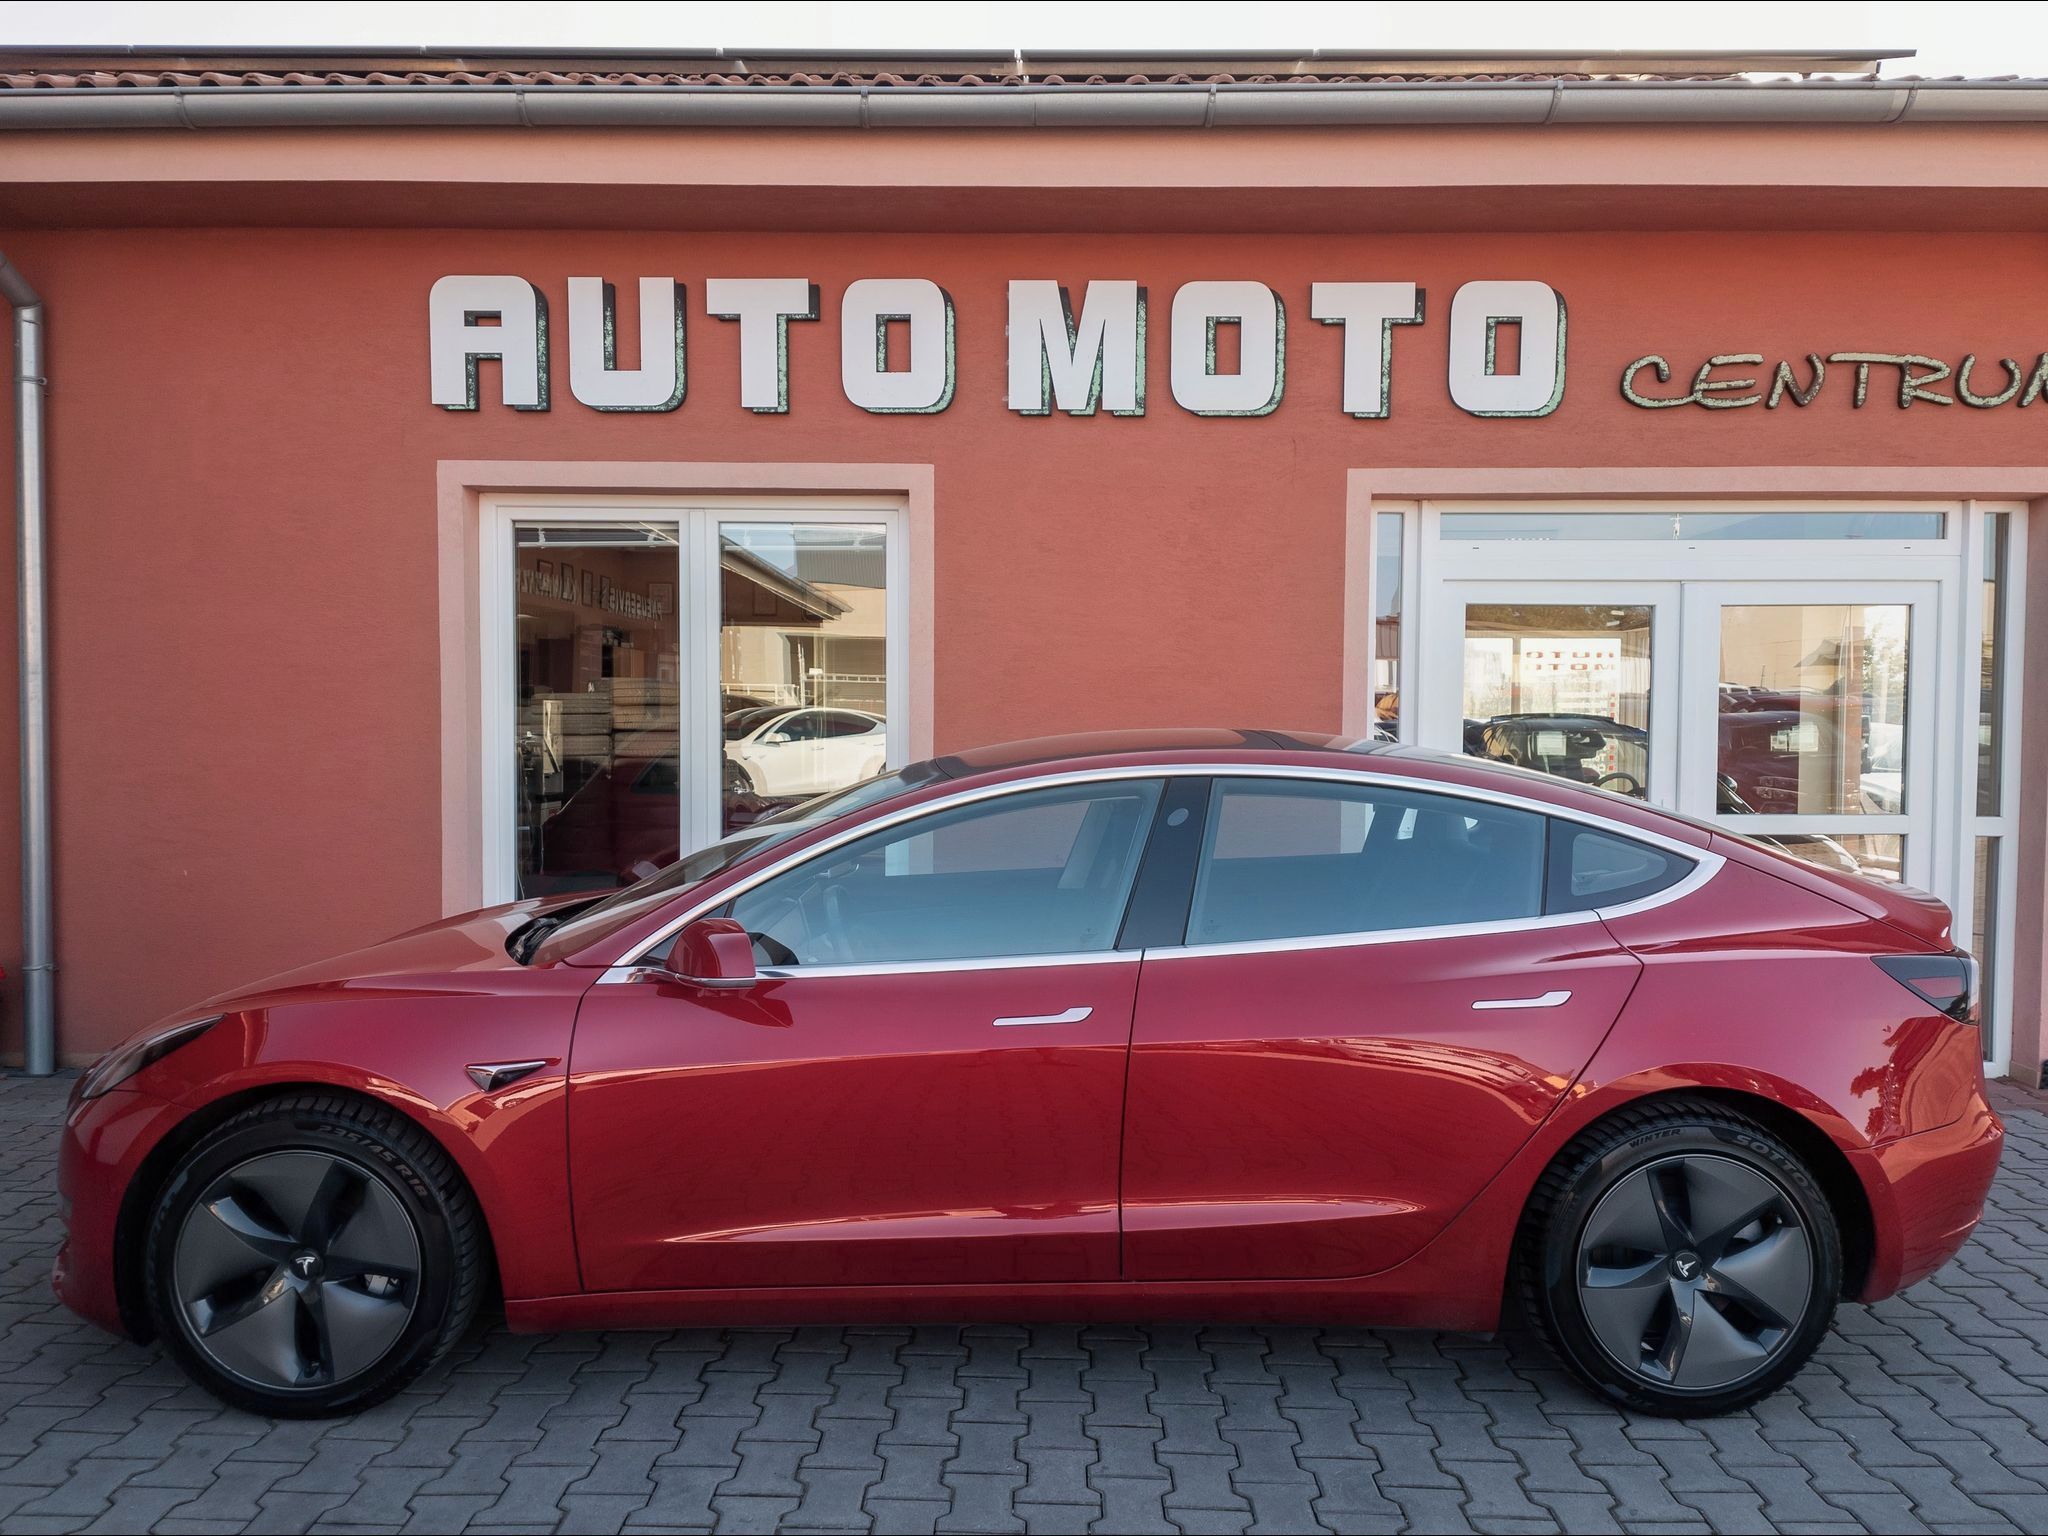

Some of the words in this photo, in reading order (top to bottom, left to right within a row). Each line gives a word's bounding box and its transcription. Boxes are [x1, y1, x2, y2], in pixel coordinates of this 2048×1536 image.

[429, 275, 957, 414] AUTO
[1008, 279, 1567, 419] MOTO
[1629, 1128, 1681, 1148] WINTER
